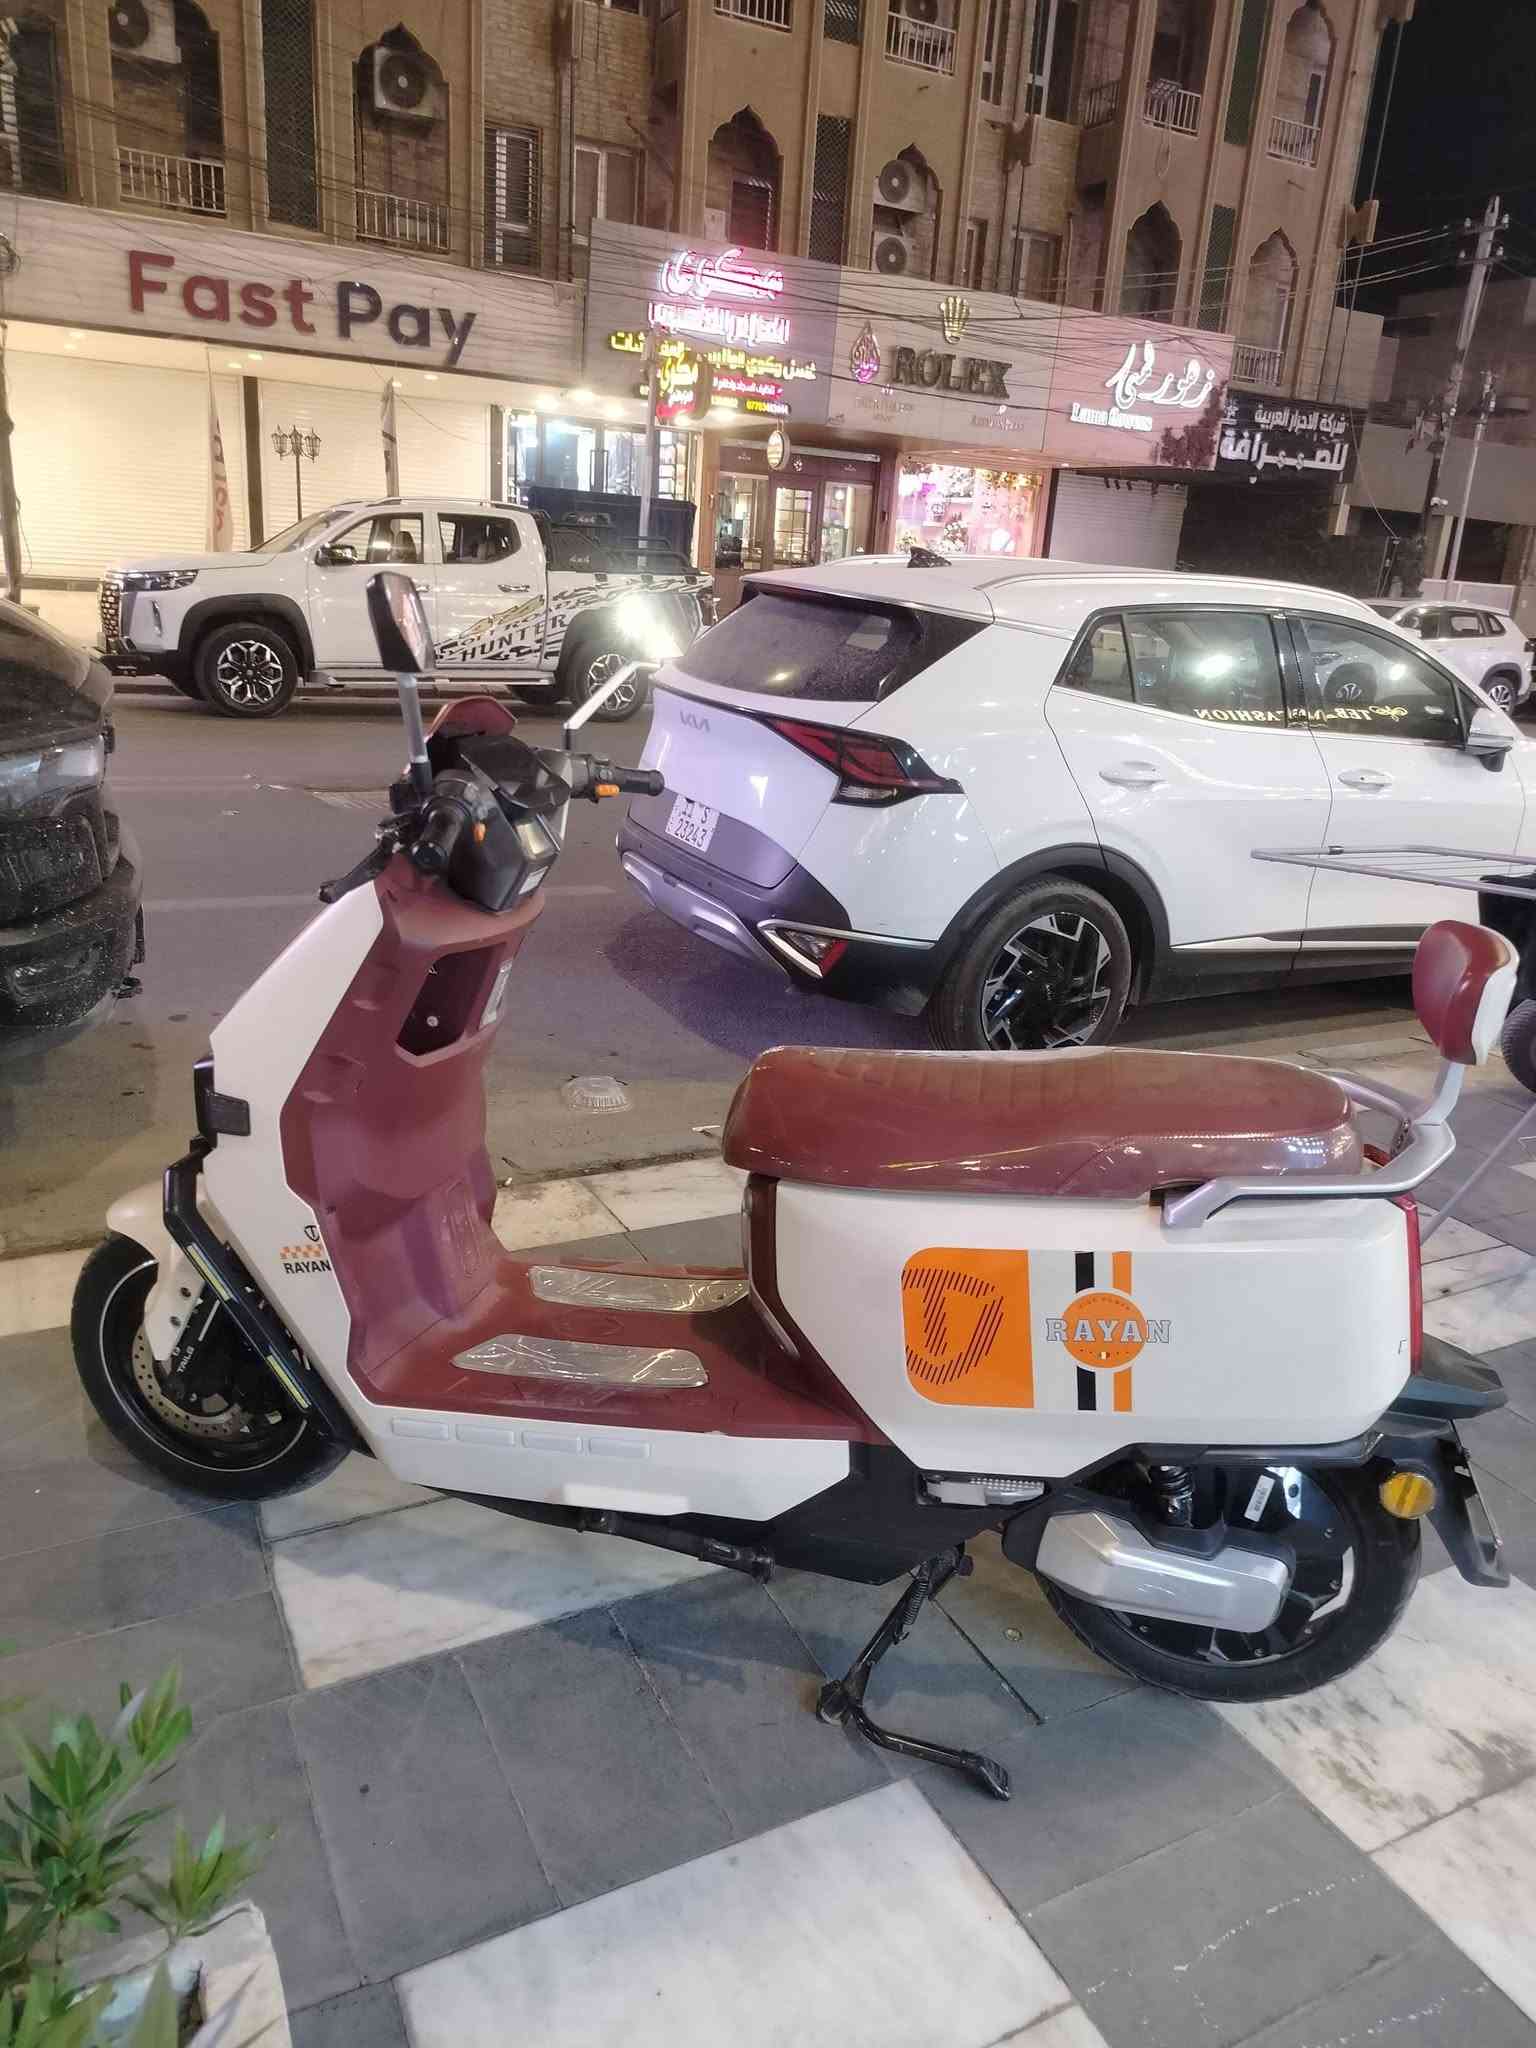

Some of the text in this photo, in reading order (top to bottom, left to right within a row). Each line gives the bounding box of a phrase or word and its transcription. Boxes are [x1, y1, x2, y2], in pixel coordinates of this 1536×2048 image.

[127, 249, 478, 367] Fast Pay
[892, 346, 1013, 399] ROLEX
[1320, 413, 1347, 437] شركة
[460, 611, 569, 662] HUNTER
[680, 710, 711, 733] KIA
[282, 1261, 332, 1274] RAYAN
[1045, 1317, 1171, 1344] RAYAN
